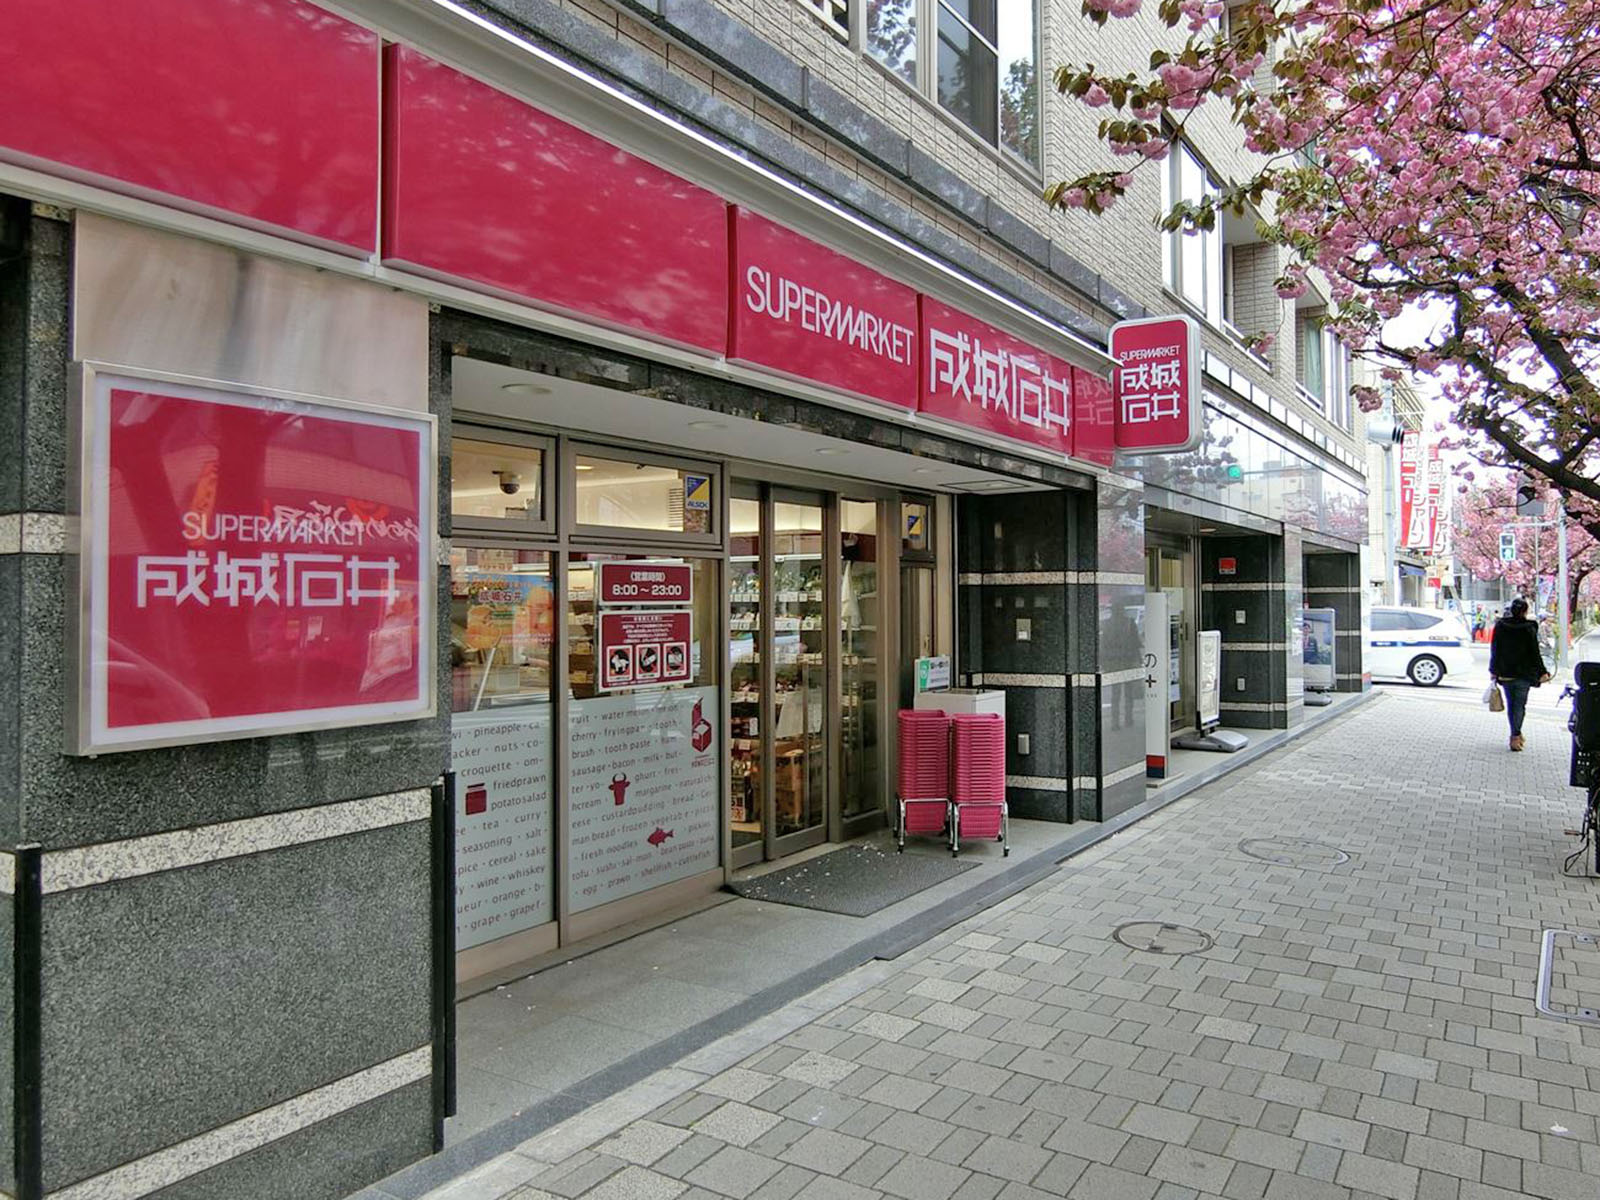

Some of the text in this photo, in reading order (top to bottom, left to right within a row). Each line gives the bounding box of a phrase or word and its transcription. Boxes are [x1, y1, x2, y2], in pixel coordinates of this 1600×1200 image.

[747, 265, 914, 366] SUPERMARKET
[1120, 345, 1180, 361] SUPERMARKET
[929, 328, 1071, 436] 成城石井
[1121, 359, 1181, 394] 成城
[1121, 390, 1181, 424] 石井
[181, 511, 366, 546] SUPERMARKET
[137, 550, 400, 608] 成城石井
[612, 584, 638, 596] 8:00
[651, 584, 682, 597] 23:00
[474, 722, 521, 738] pineapple
[572, 731, 596, 742] cherry
[494, 742, 519, 753] nuts
[572, 748, 595, 759] brush
[604, 743, 628, 754] tooth
[461, 761, 512, 778] croquette
[572, 763, 605, 776] sausage
[612, 758, 636, 769] bacon
[493, 774, 546, 790] friedprawn
[482, 820, 499, 830] tea
[514, 811, 541, 824] curry
[462, 827, 541, 854] seasoning salt
[488, 851, 517, 867] cereal
[526, 846, 546, 857] sake
[580, 848, 604, 861] fresh
[476, 876, 500, 889] wine
[507, 864, 546, 881] whiskey
[491, 886, 526, 904] orange
[470, 912, 501, 932] grape
